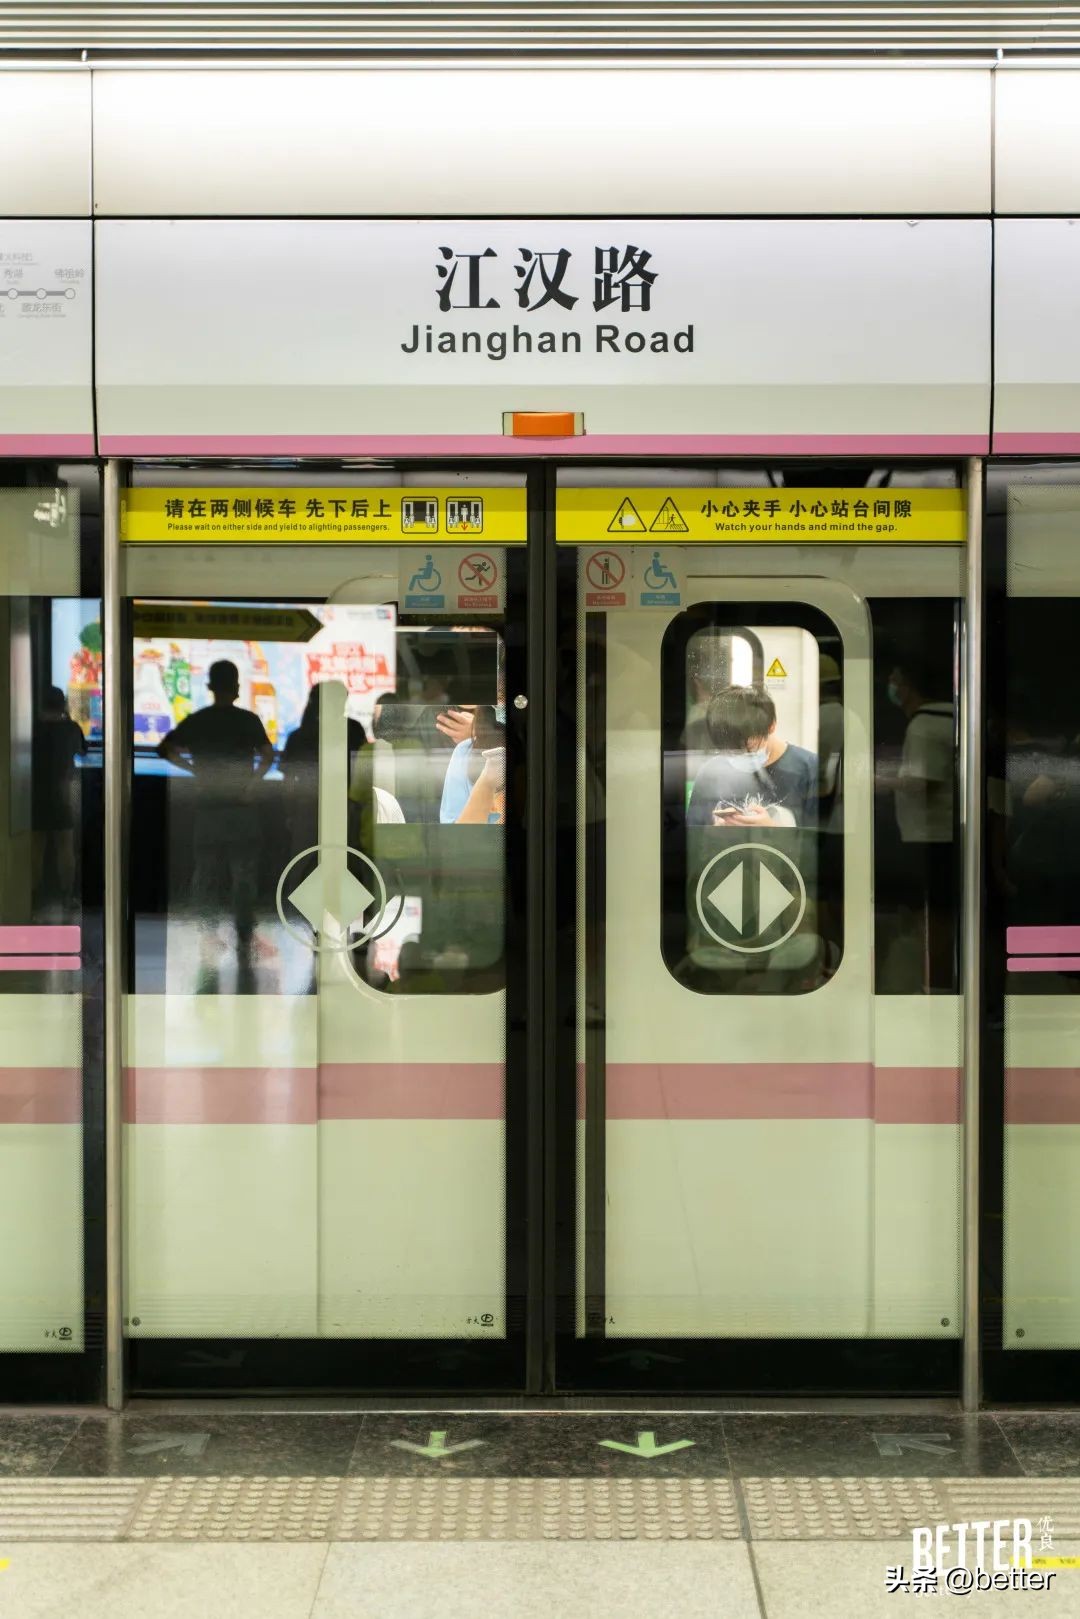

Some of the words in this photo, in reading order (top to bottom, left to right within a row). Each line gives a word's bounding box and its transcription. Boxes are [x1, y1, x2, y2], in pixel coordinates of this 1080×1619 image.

[435, 245, 659, 312] 江汉路
[401, 325, 581, 361] Jianghan
[596, 325, 694, 353] Road
[165, 499, 297, 518] 请在两侧候车
[306, 499, 392, 518] 先下后上
[701, 500, 782, 518] 小心夹手
[789, 500, 912, 518] 小心站台间隙
[167, 523, 193, 531] Please
[194, 523, 210, 531] wait
[222, 523, 245, 531] either
[246, 523, 262, 531] side
[263, 523, 278, 531] and
[279, 523, 298, 532] yield
[299, 523, 307, 531] to
[308, 523, 342, 533] alighting
[343, 524, 390, 533] passengers.
[715, 523, 747, 531] Watch
[749, 524, 773, 533] your
[774, 523, 806, 531] hands
[808, 523, 828, 531] and
[829, 523, 855, 531] mind
[857, 523, 874, 531] the
[875, 524, 898, 533] gap.
